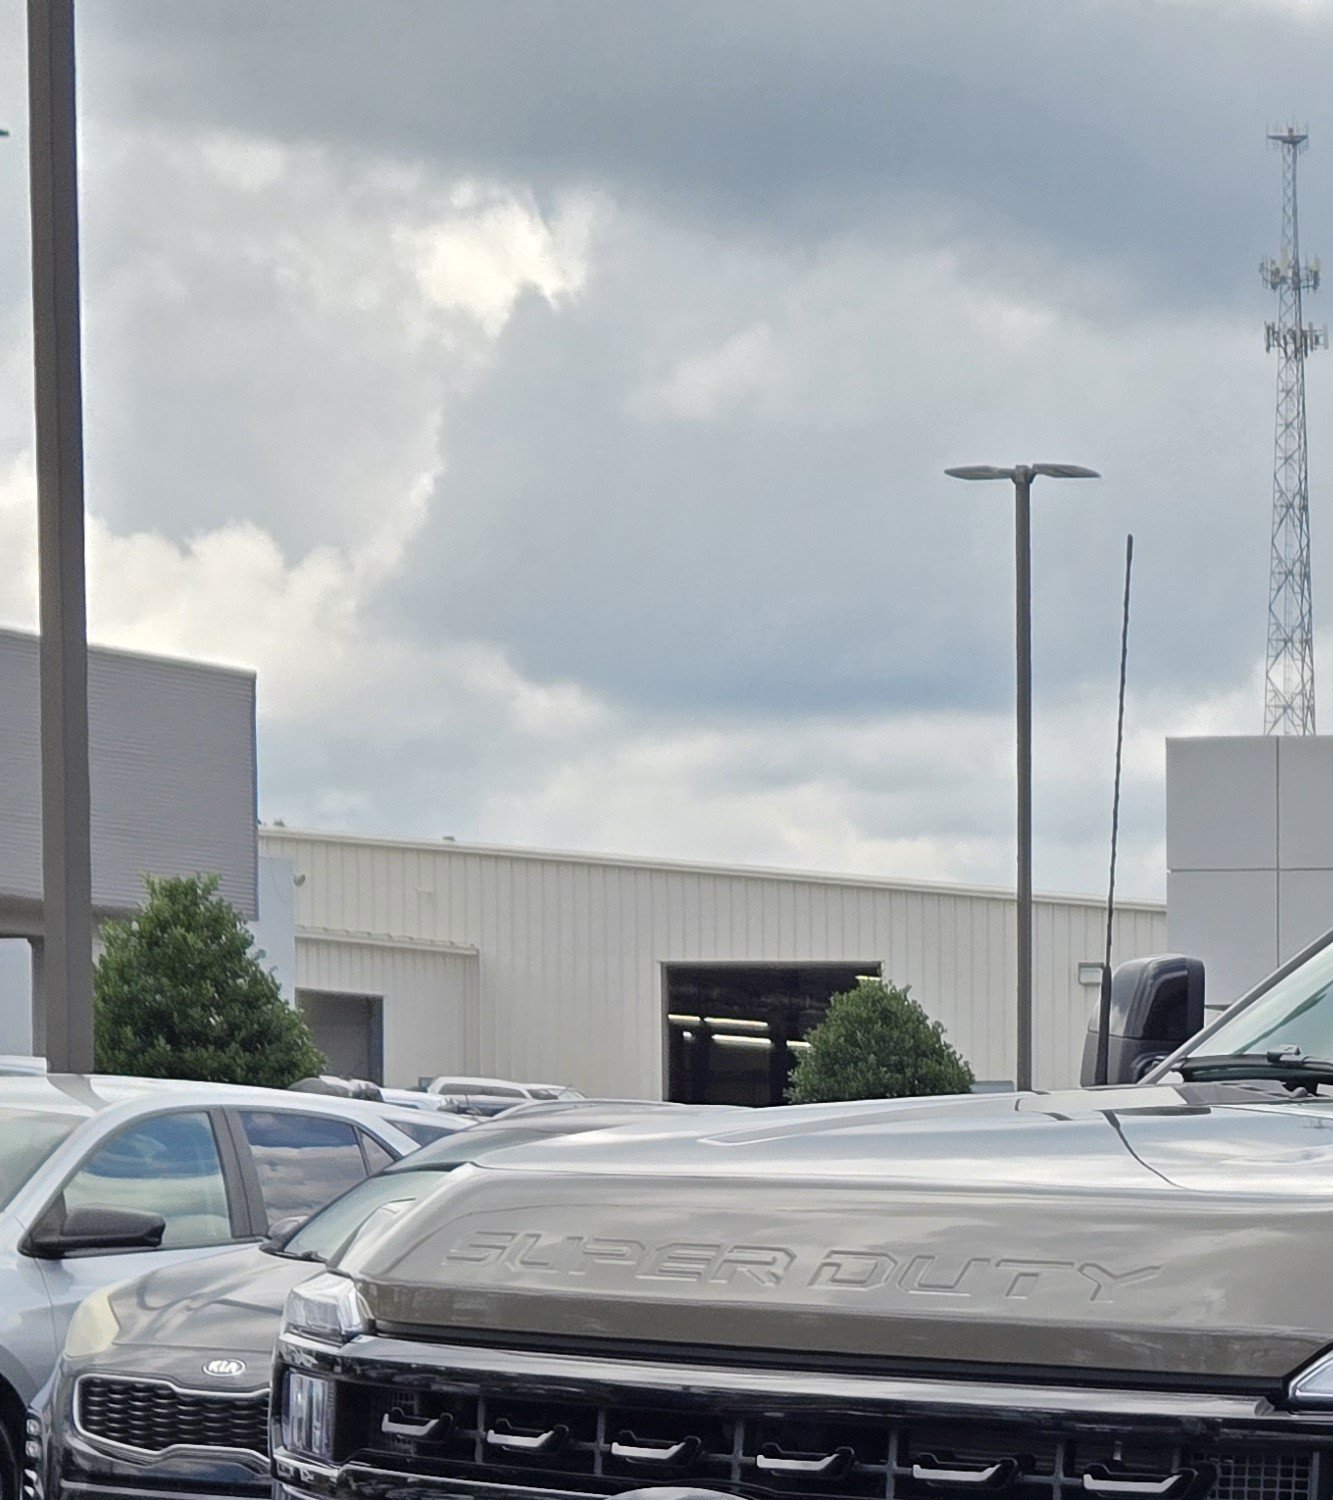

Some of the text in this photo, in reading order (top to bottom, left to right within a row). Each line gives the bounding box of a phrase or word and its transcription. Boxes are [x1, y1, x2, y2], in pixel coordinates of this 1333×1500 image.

[441, 1229, 1163, 1303] SUPER DUTY
[207, 1359, 241, 1374] KIA
